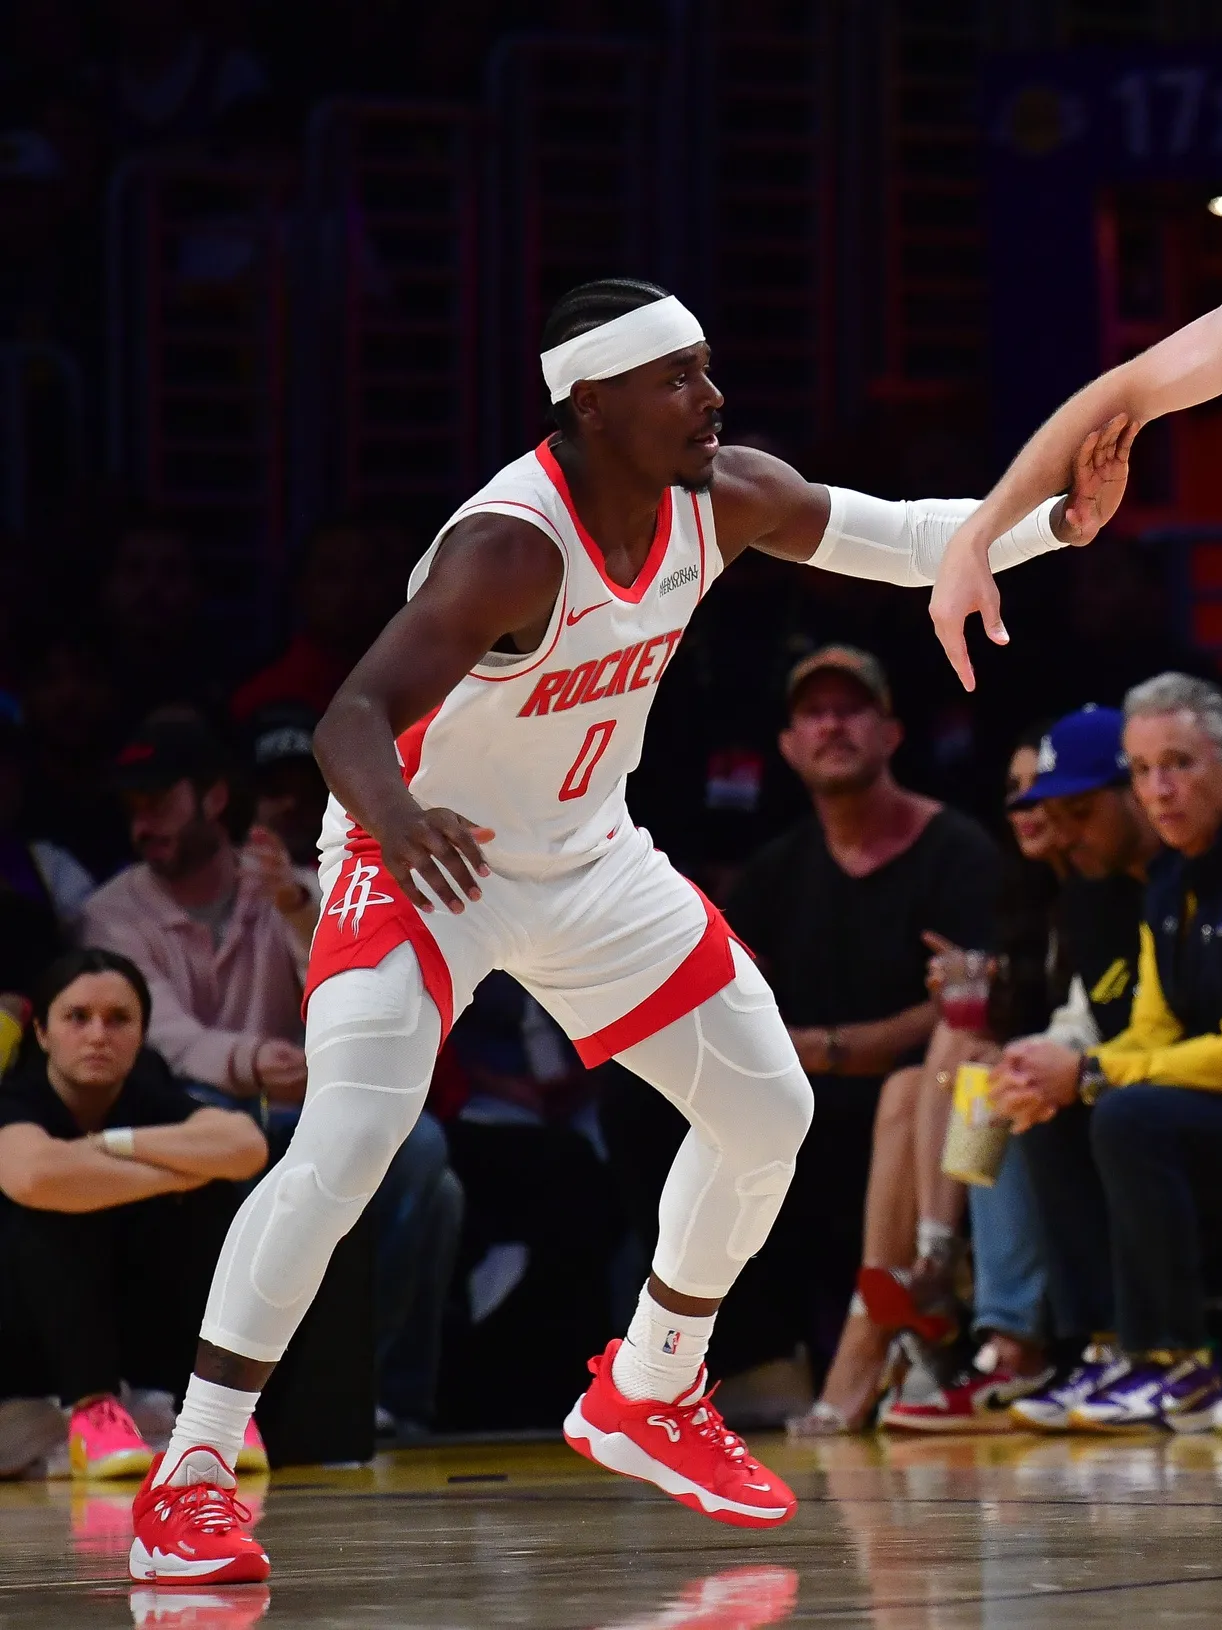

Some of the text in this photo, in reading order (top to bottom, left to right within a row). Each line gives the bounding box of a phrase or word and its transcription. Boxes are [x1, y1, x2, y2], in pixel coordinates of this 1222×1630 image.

[659, 569, 699, 598] HERMANN
[660, 564, 698, 590] MEMORIAL
[516, 627, 685, 718] ROCKET
[558, 719, 617, 802] 0
